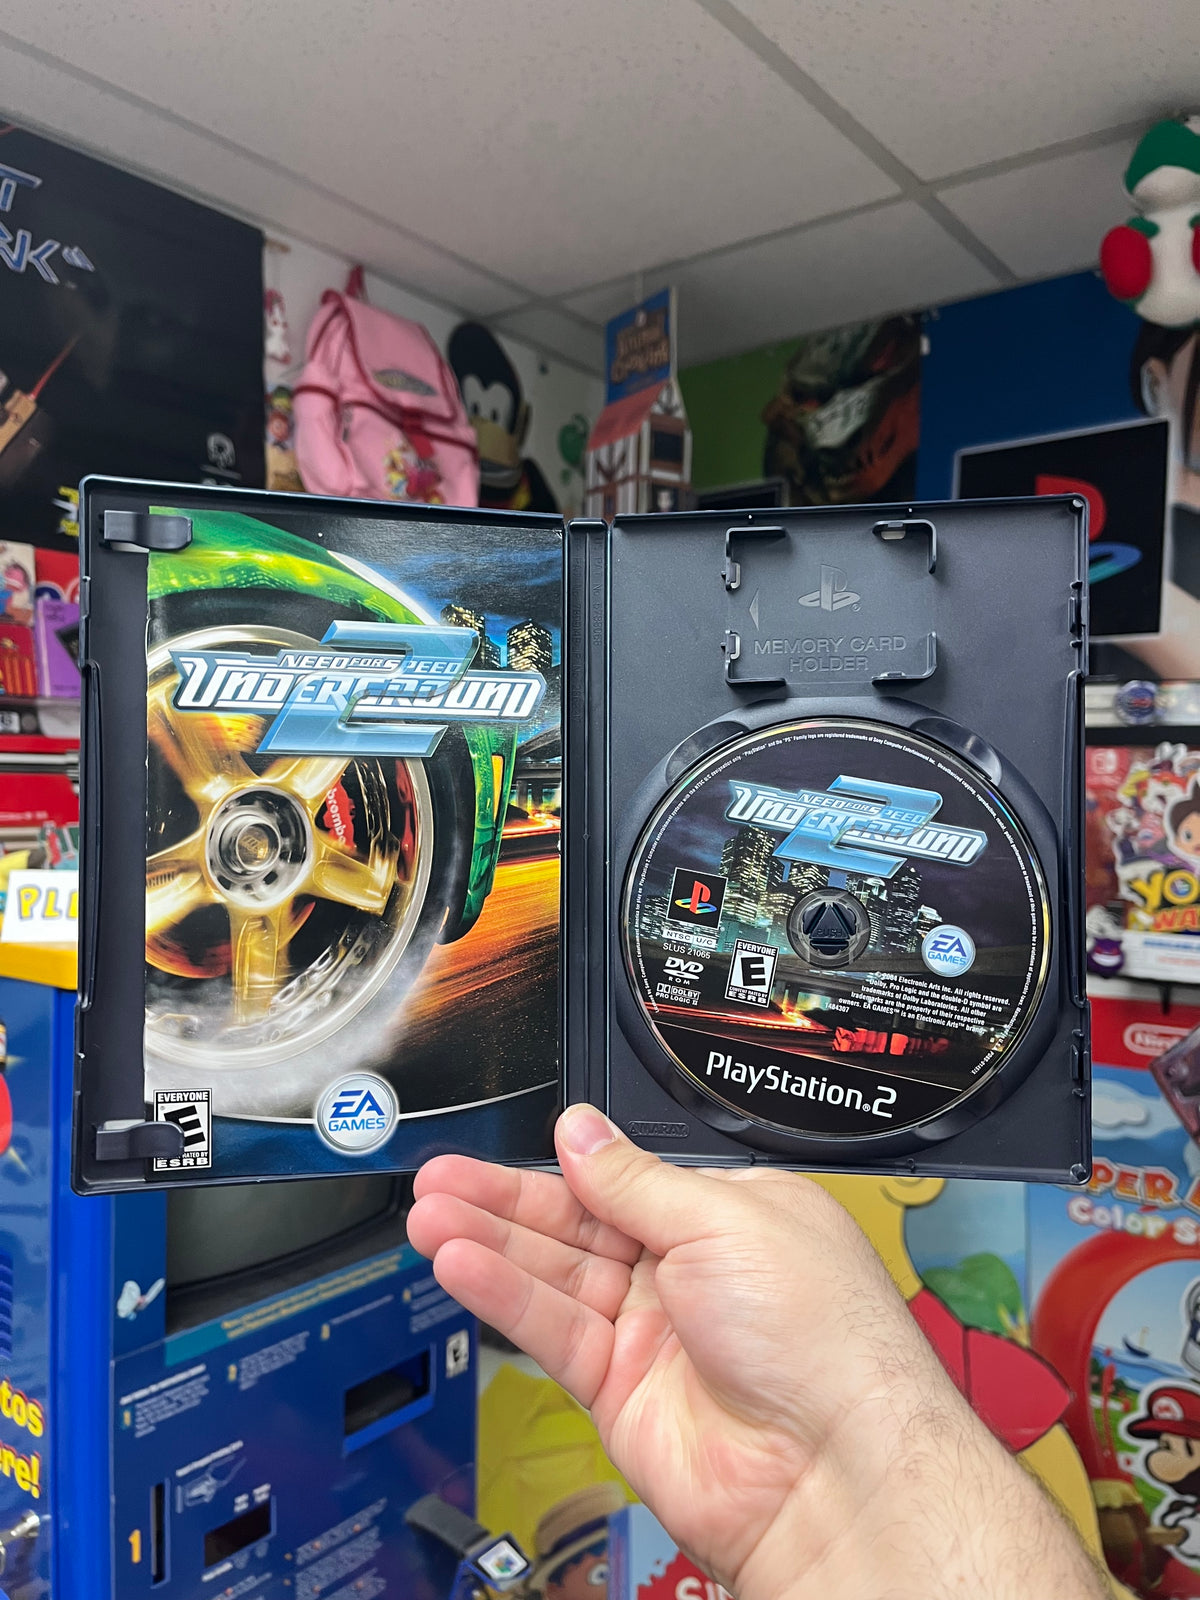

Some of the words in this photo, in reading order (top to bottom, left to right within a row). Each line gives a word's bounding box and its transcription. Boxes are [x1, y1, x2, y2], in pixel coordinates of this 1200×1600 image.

[754, 636, 846, 655] MEMORY
[850, 636, 906, 652] CARD
[279, 654, 350, 669] NEED
[350, 657, 382, 668] FOR
[380, 658, 460, 675] SPEED
[789, 656, 869, 672] HOLDER
[798, 793, 847, 809] NEED
[666, 931, 691, 941] NTSC
[696, 937, 713, 946] U/C
[930, 934, 967, 957] EA
[663, 943, 686, 954] SLUS
[687, 948, 711, 959] 21065
[737, 942, 776, 957] EVERYONE
[665, 957, 704, 973] DVD
[928, 951, 967, 966] GAMES
[741, 957, 766, 986] E
[642, 978, 650, 988] Sony
[668, 977, 690, 985] ROM
[670, 994, 691, 1004] LOGIC
[672, 986, 698, 998] DOLBY
[728, 991, 767, 1004] ESRB
[890, 982, 900, 990] Pro
[901, 985, 917, 994] Logic
[918, 989, 930, 997] and
[941, 994, 968, 1005] double-D
[969, 1001, 991, 1009] symbol
[899, 976, 928, 988] Electronic
[929, 982, 941, 991] Arts
[942, 985, 953, 994] Inc.
[954, 988, 963, 996] All
[964, 990, 981, 999] rights
[982, 994, 1010, 1006] reserved.
[851, 991, 883, 1003] trademarks
[906, 1004, 931, 1015] property
[939, 1010, 953, 1018] their
[954, 1013, 985, 1025] respective
[862, 985, 894, 998] trademarks
[902, 994, 919, 1004] Dolby
[920, 998, 959, 1012] Laboratories.
[970, 1009, 987, 1017] other
[838, 998, 861, 1008] owners.
[863, 1002, 871, 1010] EA
[916, 1013, 945, 1025] Electronic
[157, 1091, 208, 1103] EVERYONE
[330, 1090, 386, 1119] EA
[163, 1104, 206, 1148] E
[328, 1118, 386, 1132] GAMES
[156, 1157, 209, 1168] ESRB
